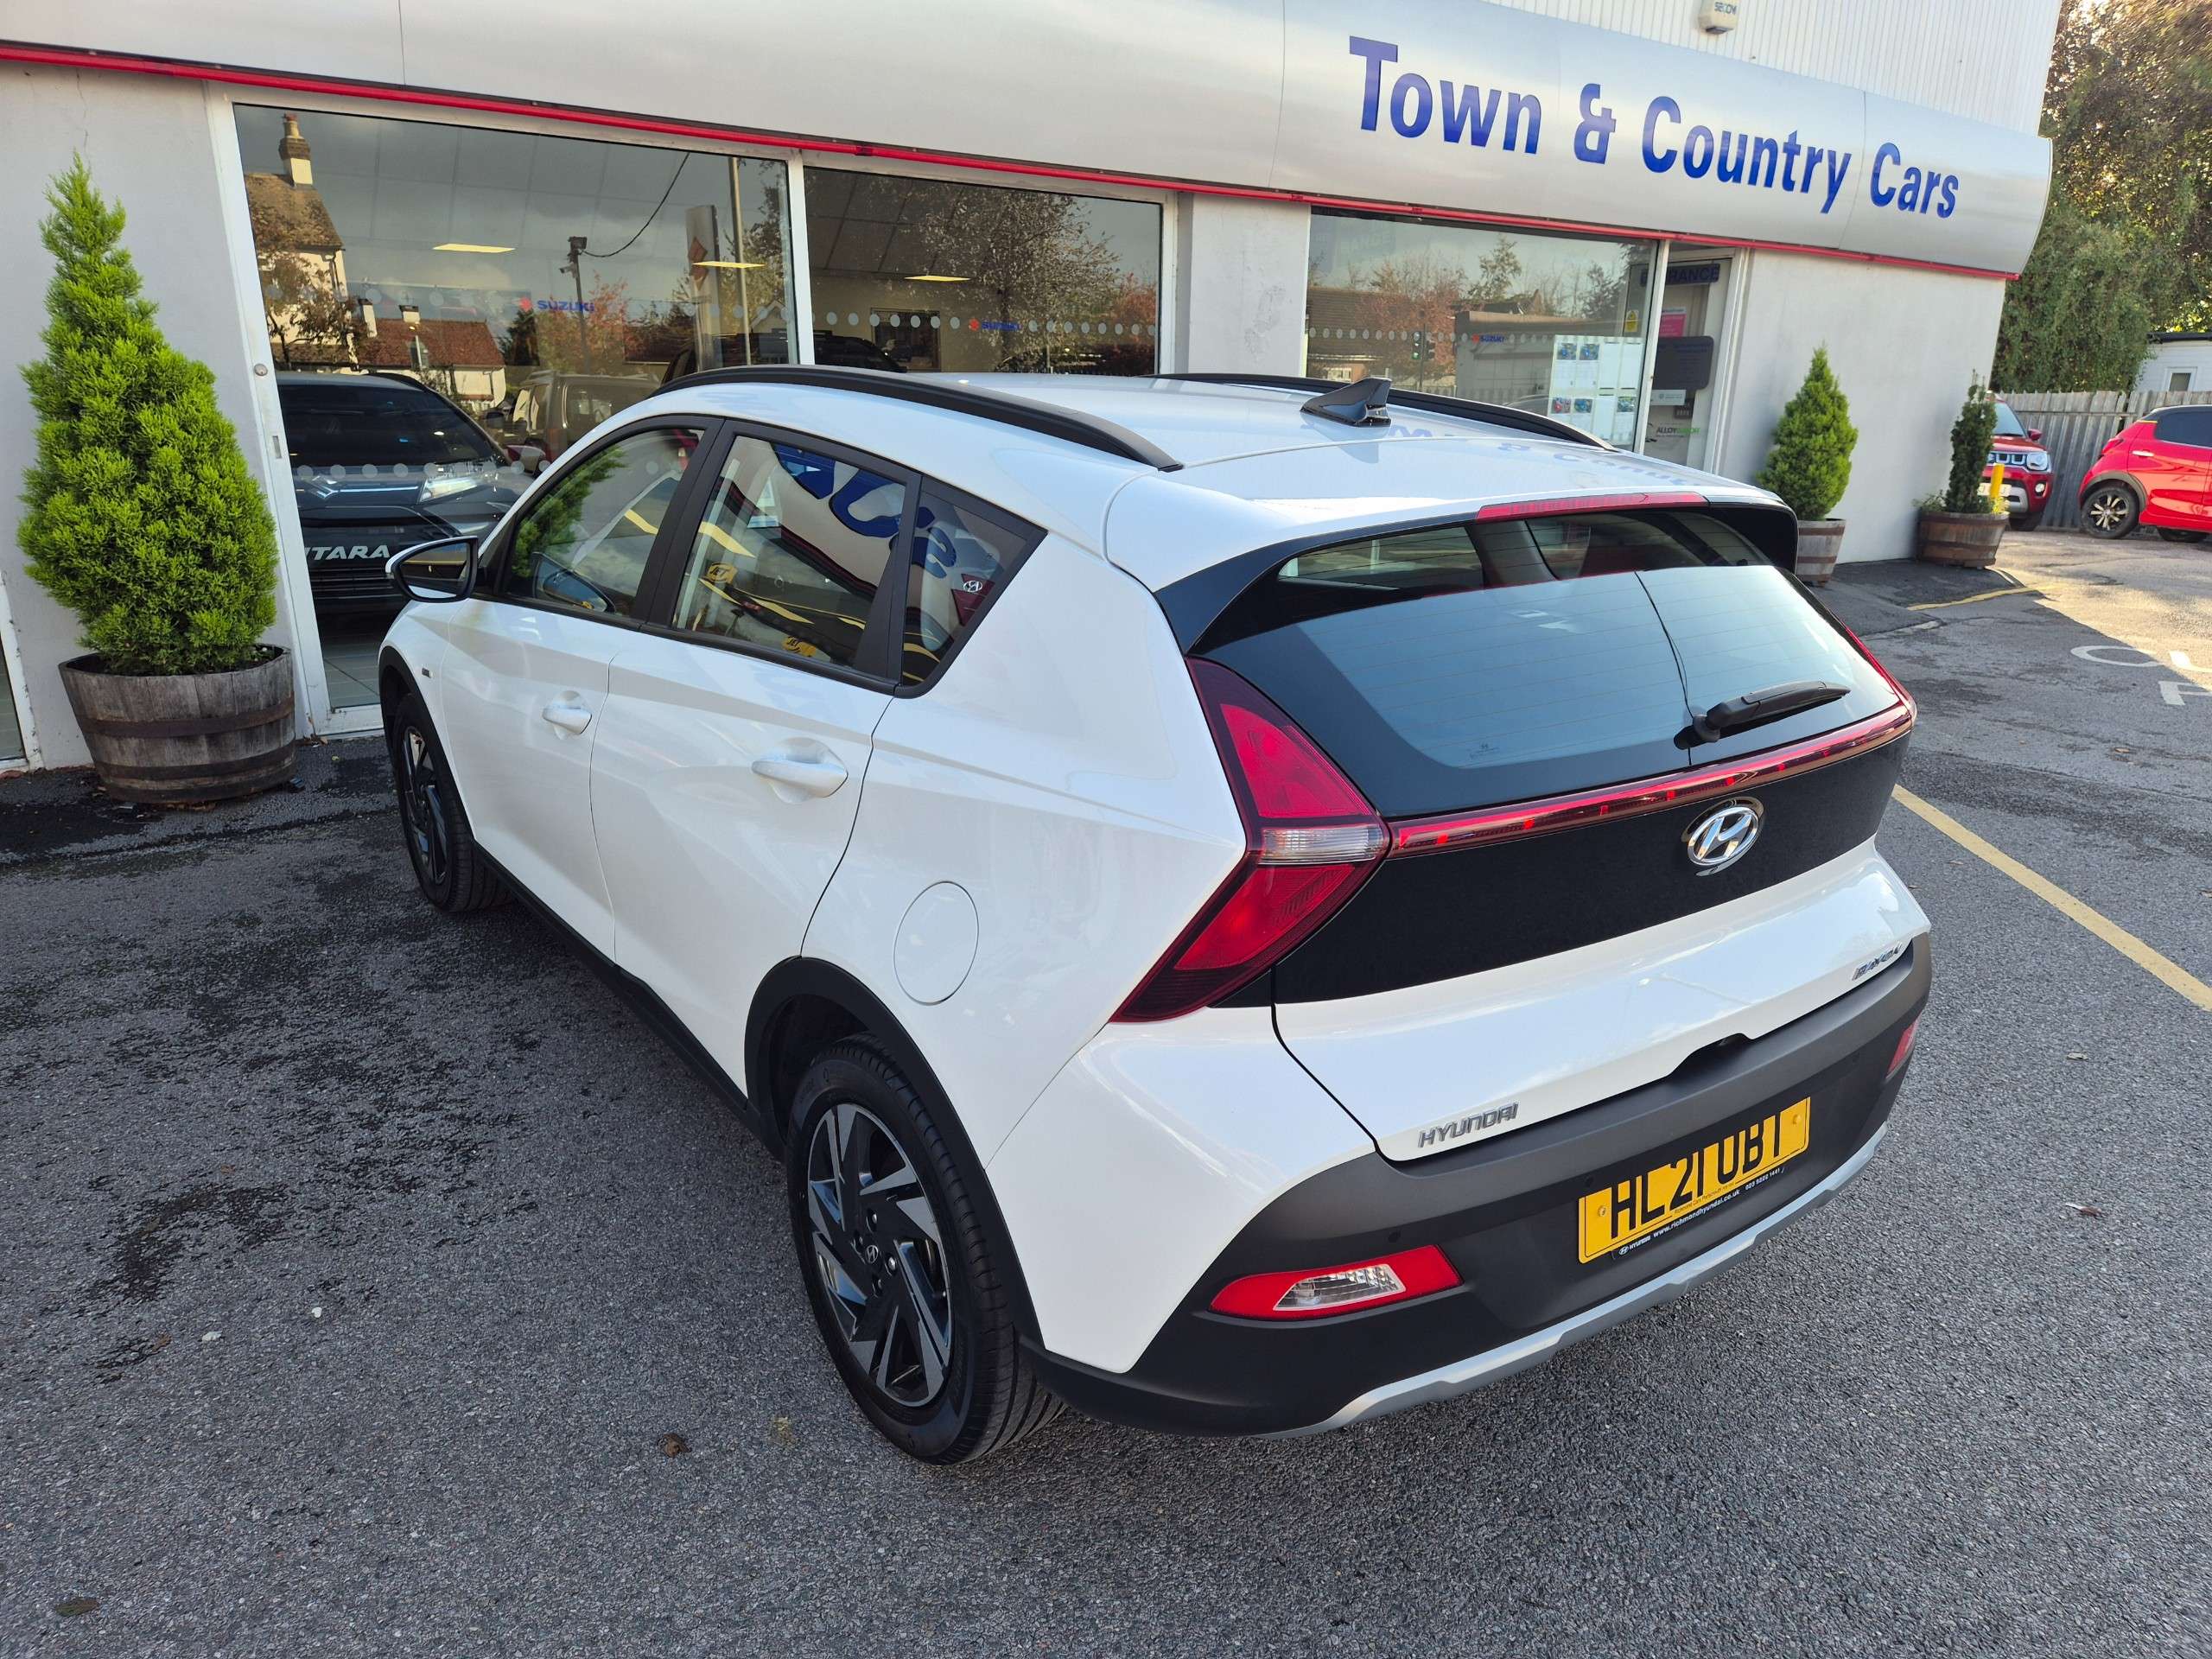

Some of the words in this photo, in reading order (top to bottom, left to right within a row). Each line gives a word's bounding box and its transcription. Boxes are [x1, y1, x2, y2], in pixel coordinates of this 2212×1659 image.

[1350, 35, 1541, 155] Town
[1573, 83, 1617, 165] &
[1642, 96, 1853, 214] Country
[1870, 142, 1959, 219] Cars
[537, 300, 594, 312] SUZUKI
[304, 544, 390, 560] ITARA
[1418, 1102, 1519, 1147] HYUNDAI
[1611, 1148, 1705, 1240] HL21
[1653, 1188, 1740, 1238] www.richmondhyundai.co.uk
